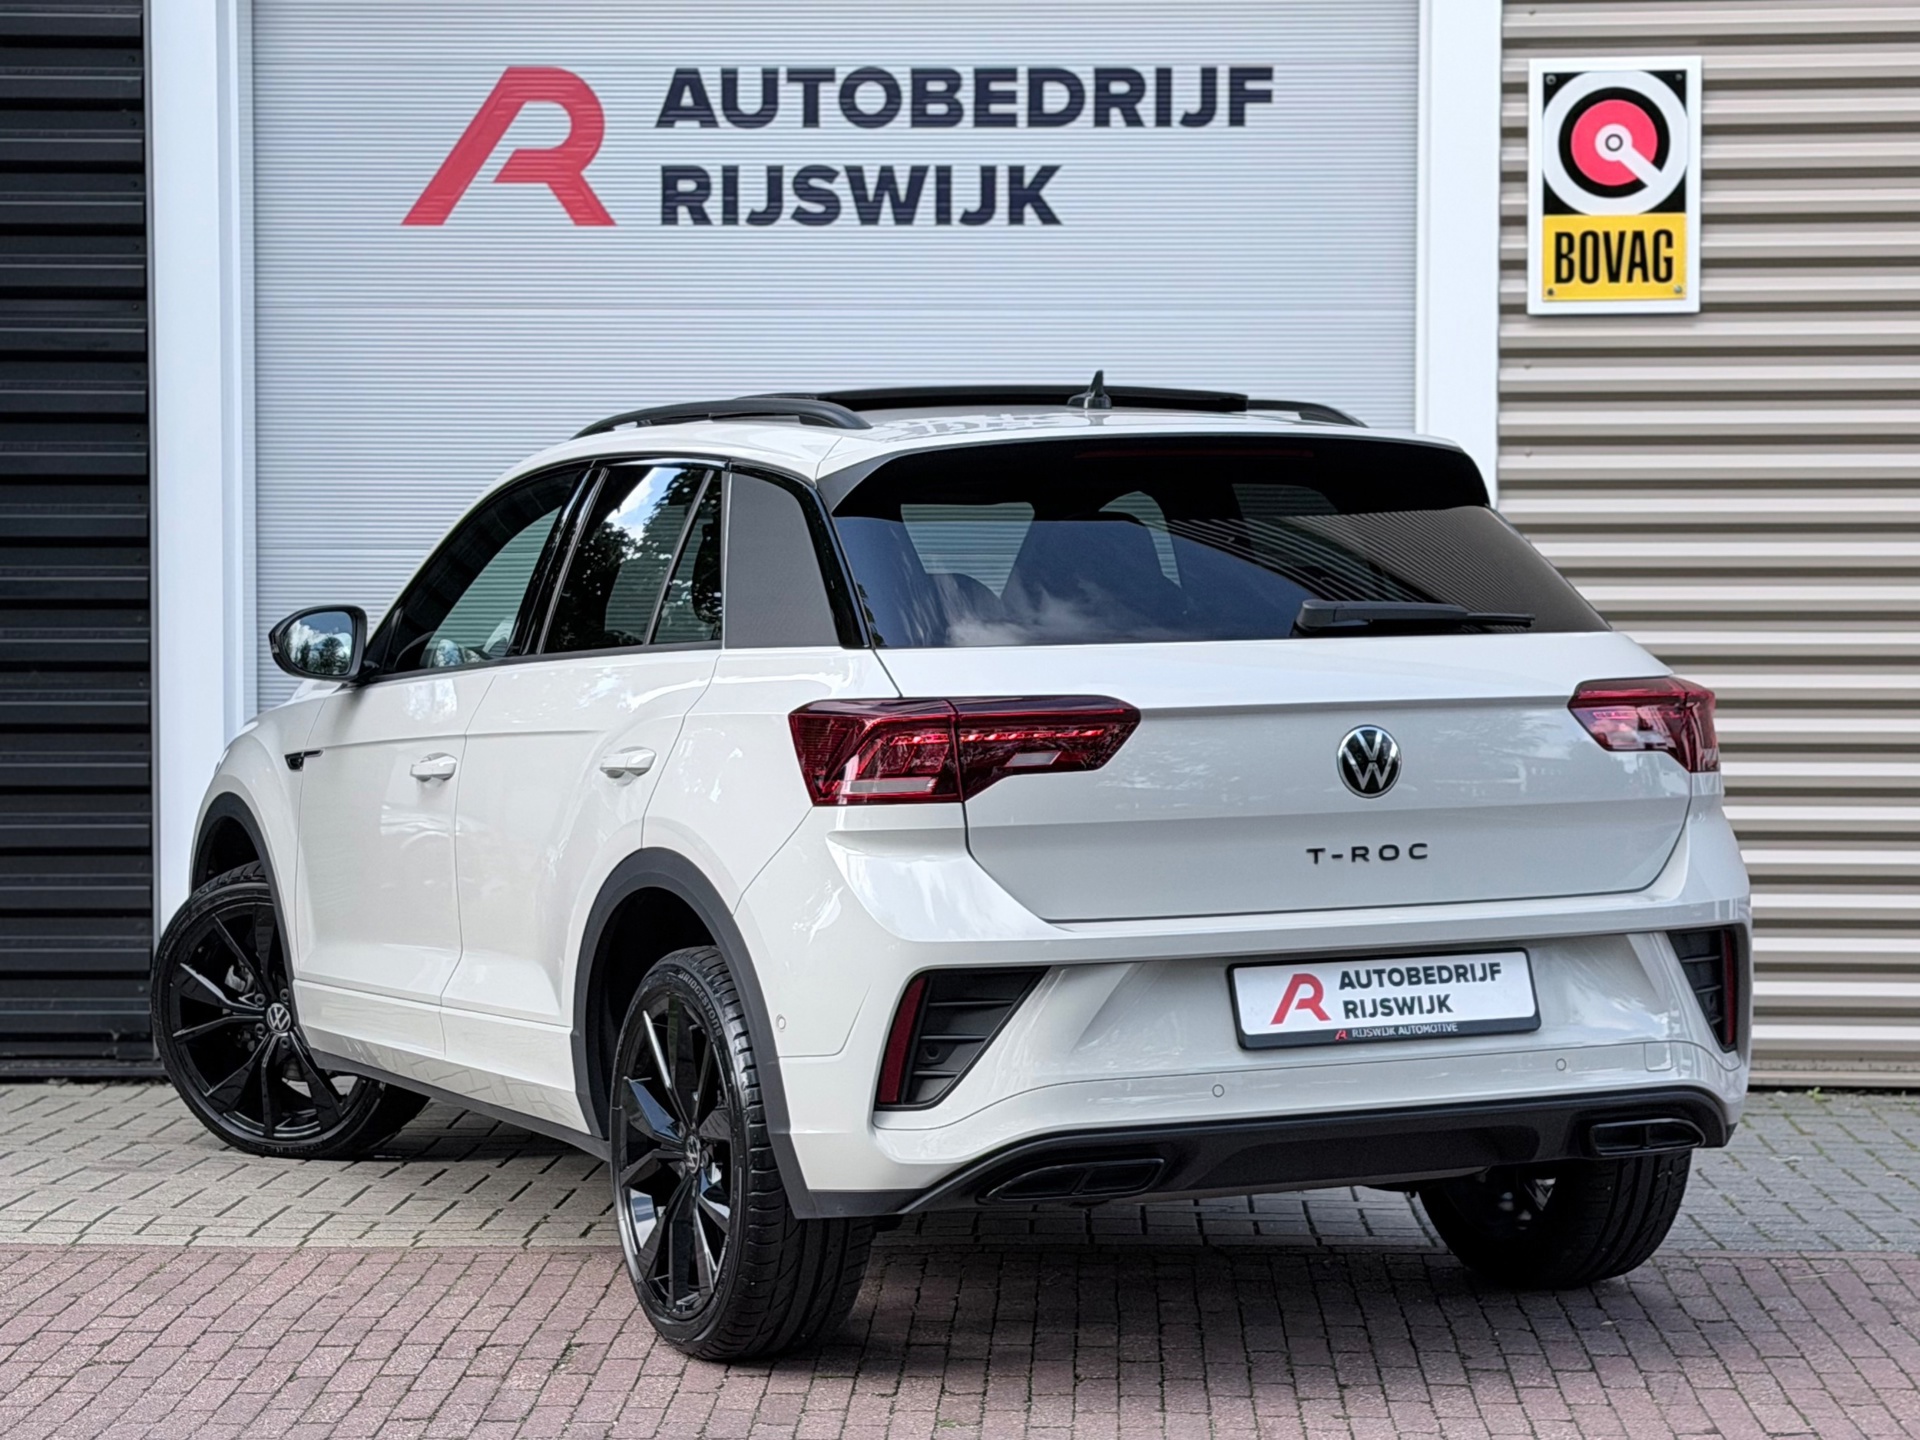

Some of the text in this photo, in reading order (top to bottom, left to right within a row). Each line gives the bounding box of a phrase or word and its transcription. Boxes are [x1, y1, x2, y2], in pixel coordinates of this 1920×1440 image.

[654, 66, 1274, 129] AUTOBEDRIJF
[660, 164, 1062, 226] RIJSWIJK
[1554, 229, 1674, 285] BOVAG
[1306, 843, 1428, 865] T-ROC
[1338, 962, 1502, 990] AUTOBEDRIJF
[1342, 993, 1454, 1019] RIJSWIJK
[1351, 1026, 1396, 1038] RIJSWIJK
[1398, 1022, 1458, 1035] AUTOMOTIVE
